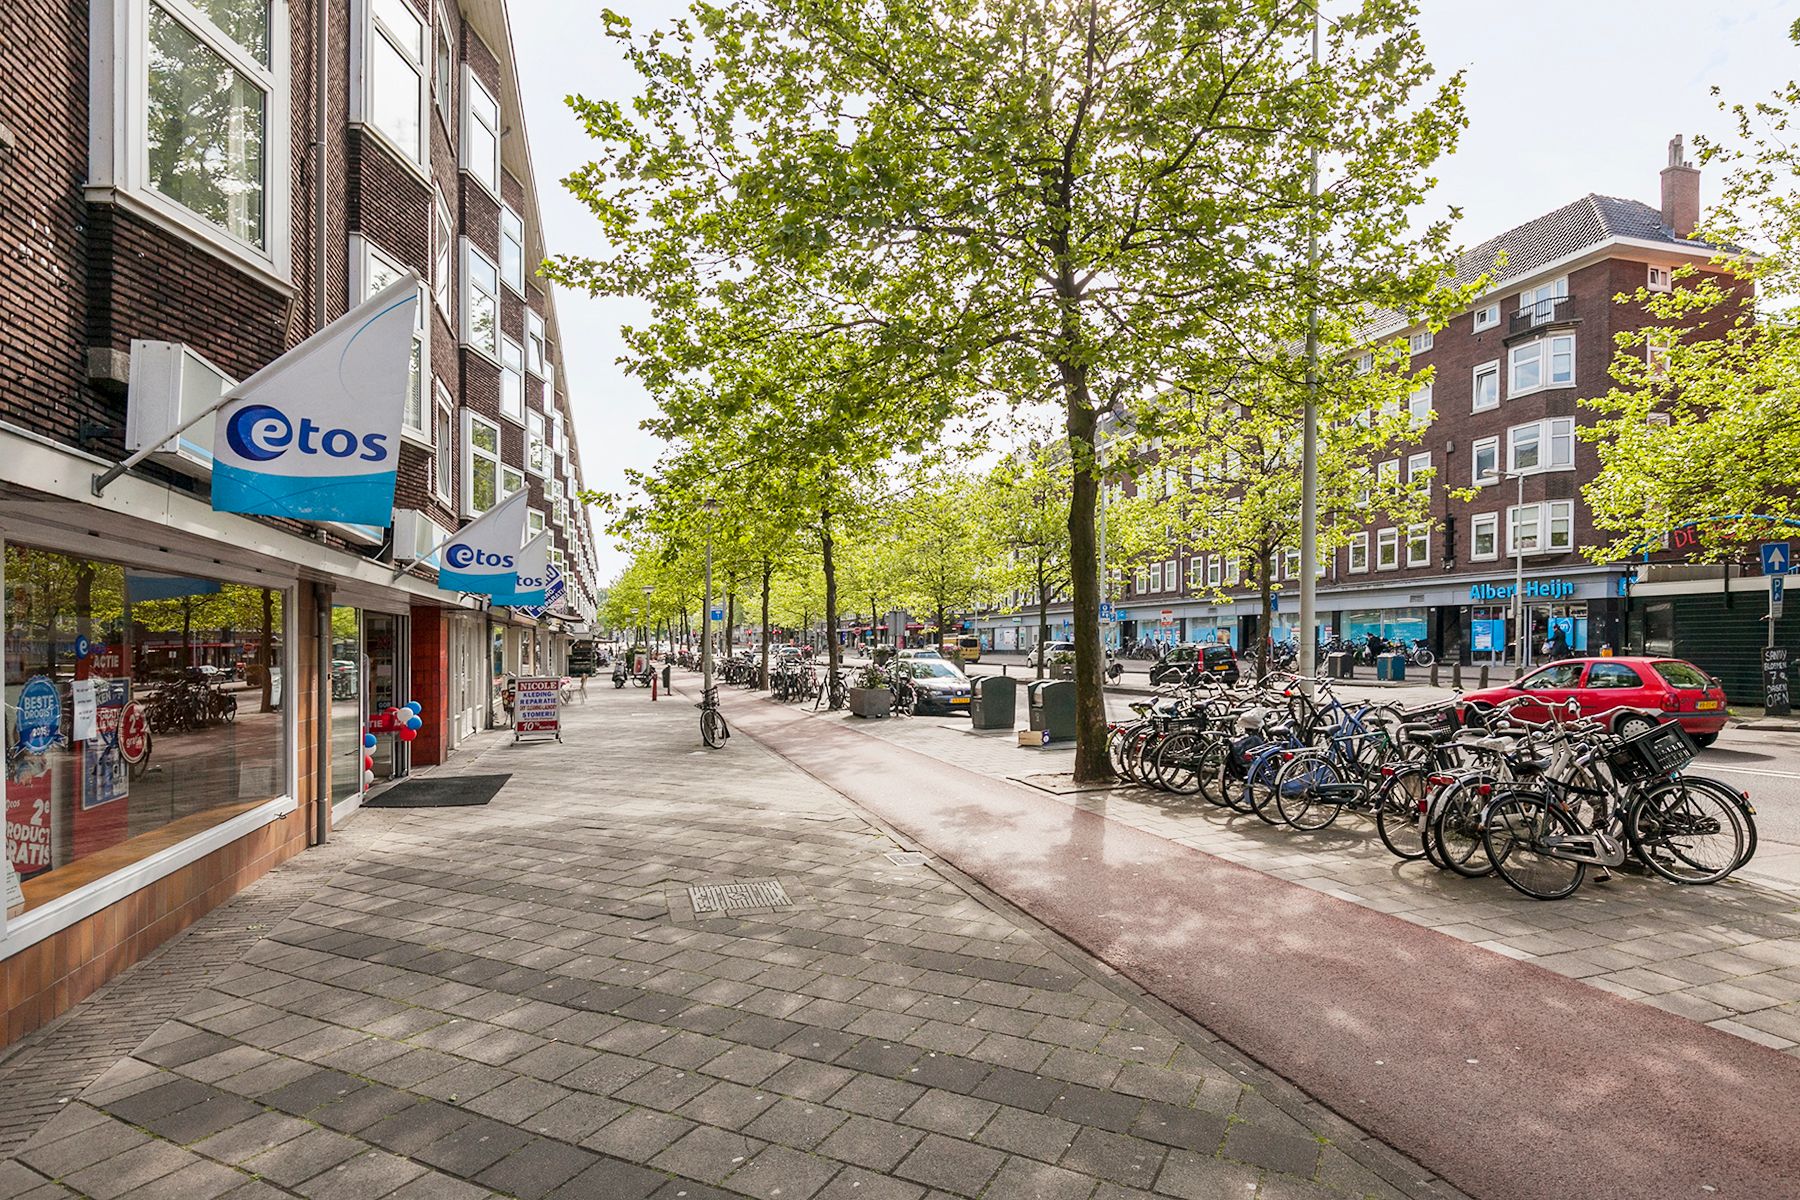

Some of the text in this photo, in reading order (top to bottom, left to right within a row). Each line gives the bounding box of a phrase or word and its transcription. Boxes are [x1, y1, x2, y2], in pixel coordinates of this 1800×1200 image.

[226, 404, 388, 461] etos
[446, 543, 514, 568] etos
[516, 575, 543, 587] tos
[1526, 579, 1574, 598] Heijn
[94, 655, 120, 668] ACTIE
[1769, 671, 1777, 684] 7
[520, 682, 557, 690] NICOLE
[24, 695, 55, 710] BESTE
[1766, 692, 1789, 707] OPEN
[24, 708, 54, 719] DROGIST
[6, 821, 50, 844] RODUCT
[6, 839, 50, 865] RATIS
